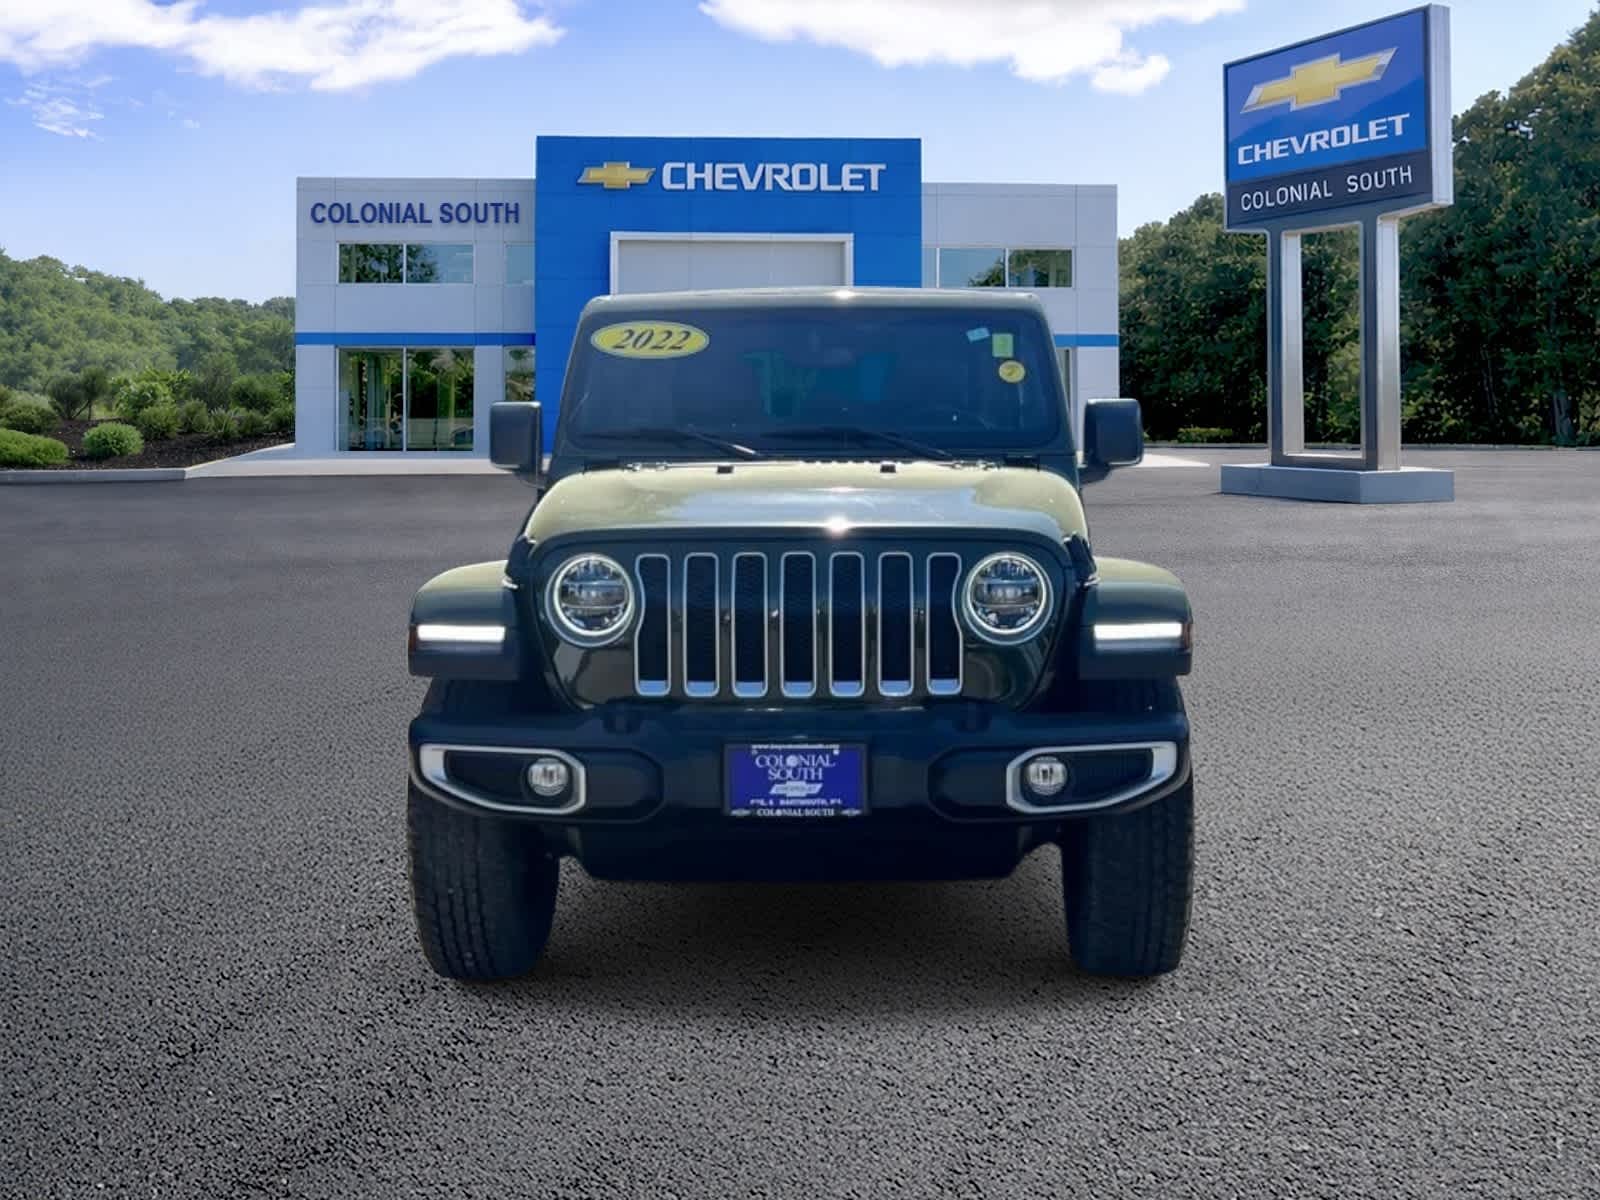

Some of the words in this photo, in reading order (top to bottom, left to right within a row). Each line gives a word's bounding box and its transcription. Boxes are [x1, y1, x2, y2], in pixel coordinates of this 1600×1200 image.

[1238, 113, 1410, 165] CHEVROLET
[662, 162, 886, 191] CHEVROLET
[1241, 180, 1333, 211] COLONIAL
[1347, 165, 1412, 194] SOUTH
[310, 202, 432, 224] COLONIAL
[439, 202, 520, 224] SOUTH
[612, 329, 692, 350] 2022
[755, 754, 836, 768] COLONIAL
[768, 767, 823, 781] SOUTH
